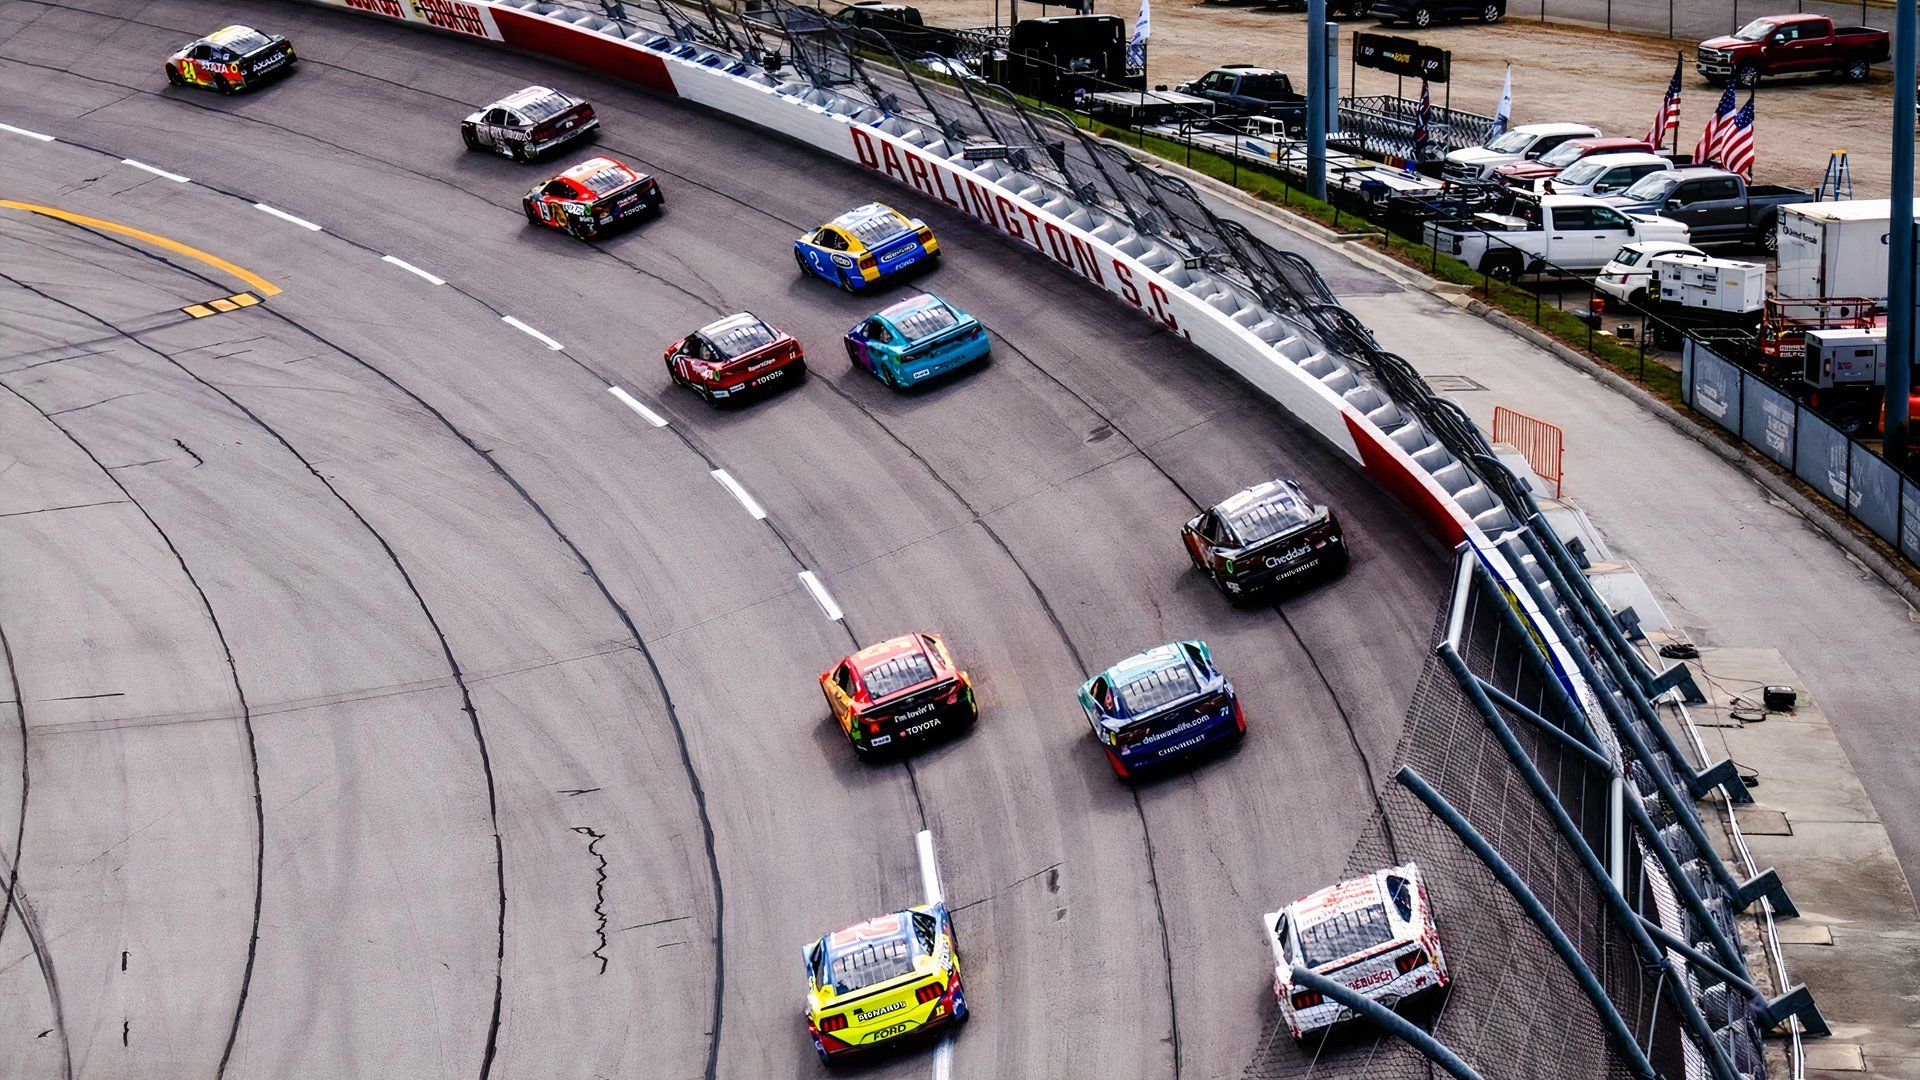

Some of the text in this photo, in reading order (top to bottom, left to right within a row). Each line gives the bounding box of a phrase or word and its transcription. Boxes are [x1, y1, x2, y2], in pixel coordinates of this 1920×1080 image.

[182, 60, 197, 82] 24
[850, 127, 1106, 288] DARLINGTON
[810, 251, 824, 271] 2
[756, 370, 784, 385] TOYOTA
[1265, 543, 1312, 569] Cheddar's
[906, 719, 941, 735] TOYOTA
[1142, 713, 1210, 746] delawarelife.com
[1158, 733, 1207, 757] CHEVROLET
[1345, 971, 1393, 991] DEBUSCH
[874, 1024, 904, 1041] FORD
